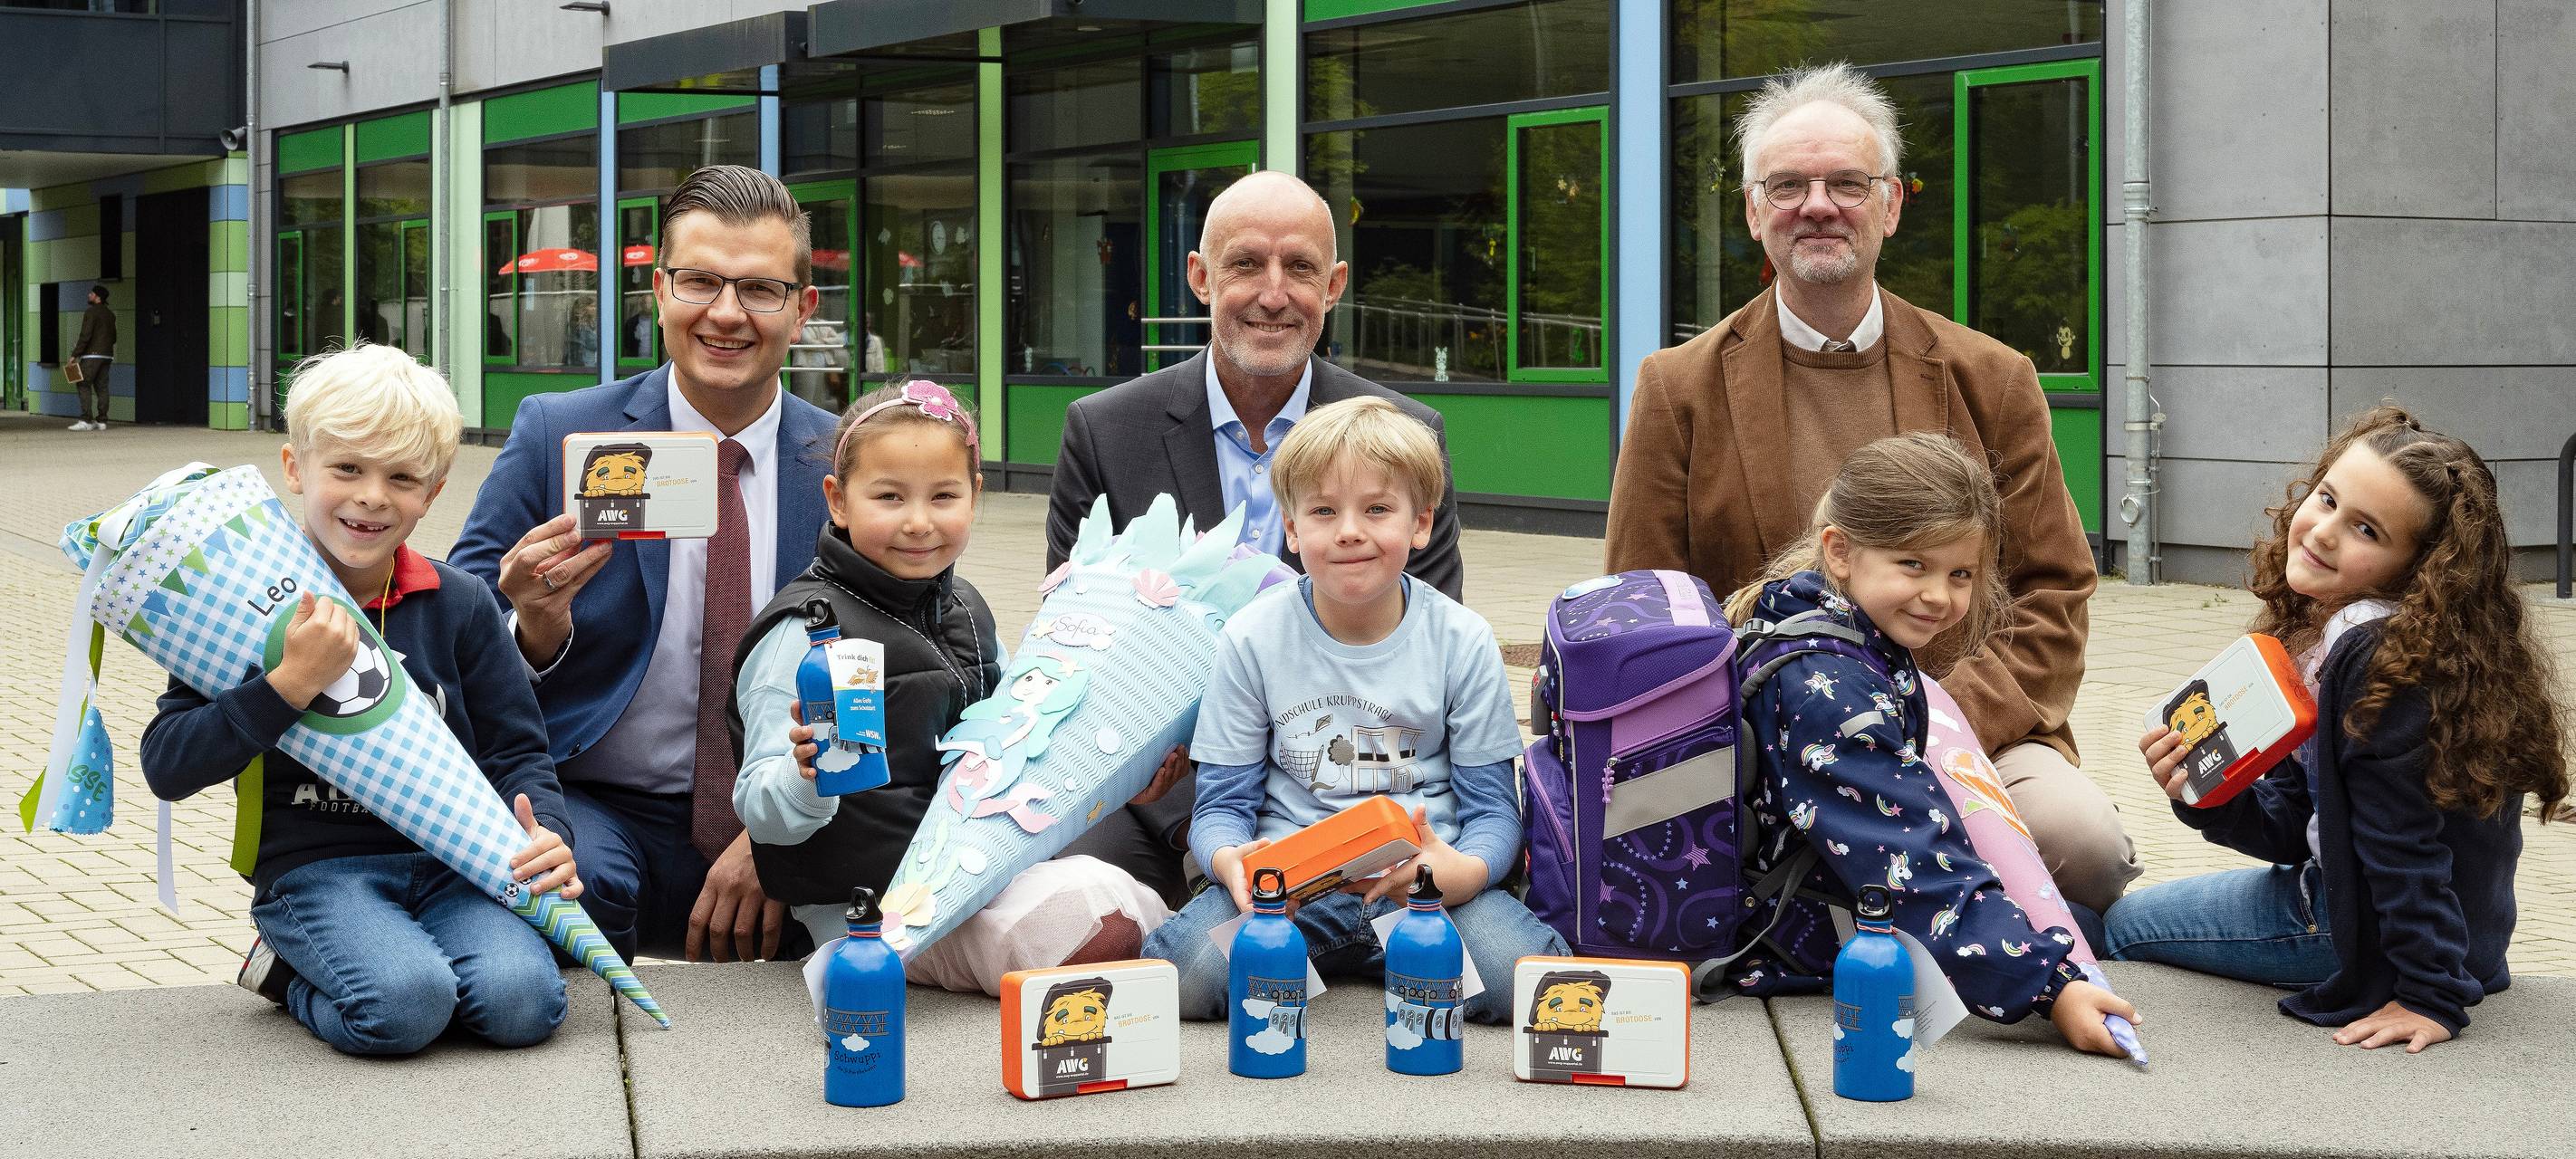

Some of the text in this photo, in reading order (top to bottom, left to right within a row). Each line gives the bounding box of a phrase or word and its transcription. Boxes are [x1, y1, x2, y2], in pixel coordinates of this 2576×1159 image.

[597, 509, 628, 522] AWG
[247, 577, 297, 616] Leo
[1055, 617, 1100, 639] Sofia
[857, 654, 869, 663] dich
[2197, 747, 2223, 775] AWG
[1118, 1014, 1152, 1028] BROTDOSE
[1616, 1014, 1653, 1024] BROTDOSE
[834, 1049, 881, 1066] Schwuppi
[1549, 1047, 1582, 1061] AWG
[1057, 1057, 1089, 1075] AWG
